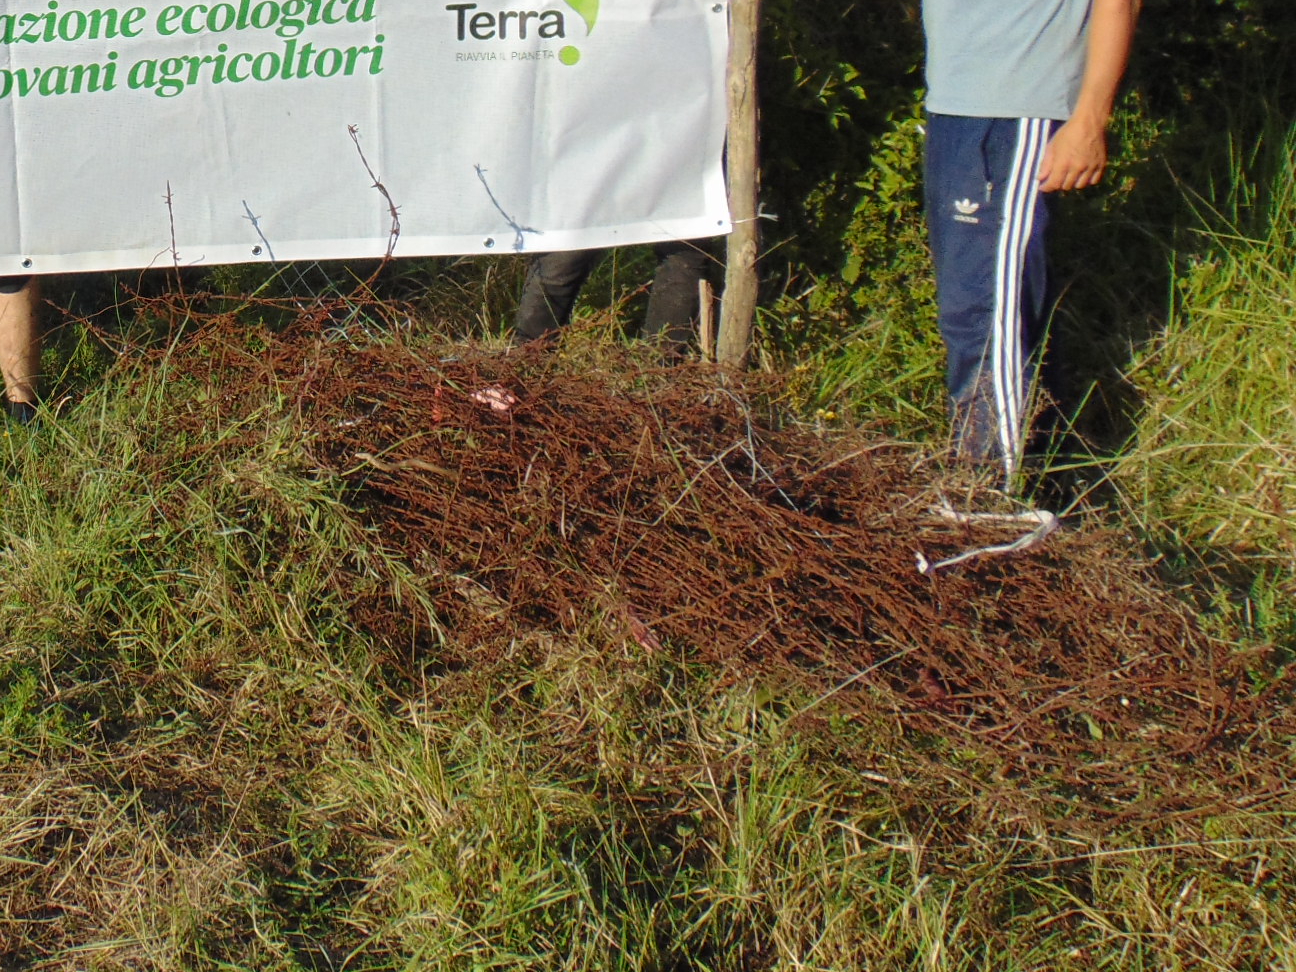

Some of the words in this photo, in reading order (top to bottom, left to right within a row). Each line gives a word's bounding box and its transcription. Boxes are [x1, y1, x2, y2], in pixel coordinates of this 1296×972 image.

[127, 34, 385, 98] agricoltori
[455, 52, 497, 62] RIAVVIA
[511, 49, 555, 61] PIANETA
